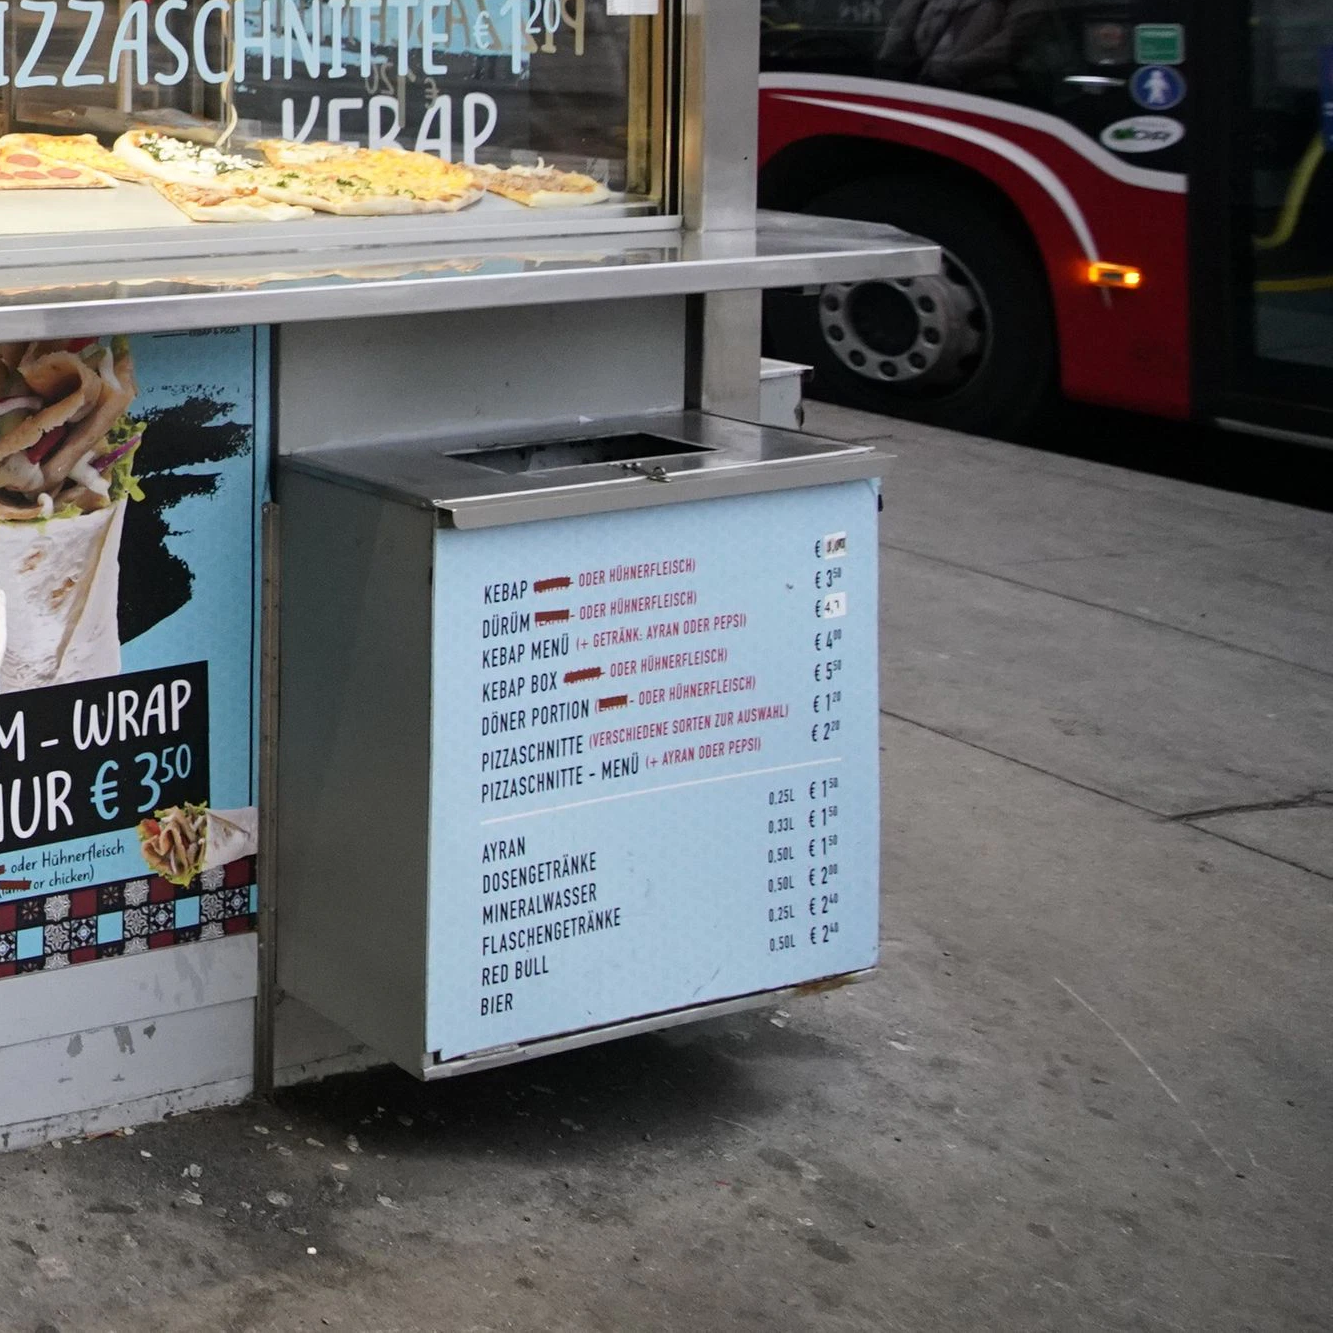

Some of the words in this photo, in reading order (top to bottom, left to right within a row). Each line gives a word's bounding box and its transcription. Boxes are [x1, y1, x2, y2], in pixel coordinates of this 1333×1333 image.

[483, 580, 528, 605] KEBAP
[609, 558, 696, 583] HÜHNERFLEISCH)
[482, 612, 530, 639] DÜRÜM
[609, 590, 697, 616] HÜHNERFLEISCH)
[482, 642, 526, 669] KEBAP
[531, 632, 569, 661] MENÜ
[593, 627, 643, 650] GETRÄNK:
[711, 613, 747, 634] PEPSI)
[482, 675, 526, 703] KEBAP
[531, 670, 558, 693] BOX
[72, 679, 191, 751] WRAP
[481, 708, 526, 737] DÖNER
[531, 698, 590, 731] PORTION
[481, 734, 584, 772] PIZZASCHNITTE
[589, 724, 670, 750] (VERSCHIEDENE
[672, 715, 711, 739] SORTEN
[714, 712, 734, 731] ZUR
[736, 703, 790, 727] AUSWAHL)
[481, 766, 584, 804] PIZZASCHNITTE
[601, 751, 640, 780] MENÜ
[11, 856, 38, 874] oder
[41, 843, 125, 871] Hühnerfleisch
[482, 837, 526, 864] AYRAN
[48, 863, 95, 889] chicken)
[482, 851, 597, 894] DOSENGETRÄNKE
[482, 883, 597, 926] MINERALWASSER
[482, 907, 622, 957] FLASCHENGETRÄNKE
[481, 963, 509, 987] RED
[515, 956, 549, 980] BULL
[480, 993, 514, 1017] BIER
